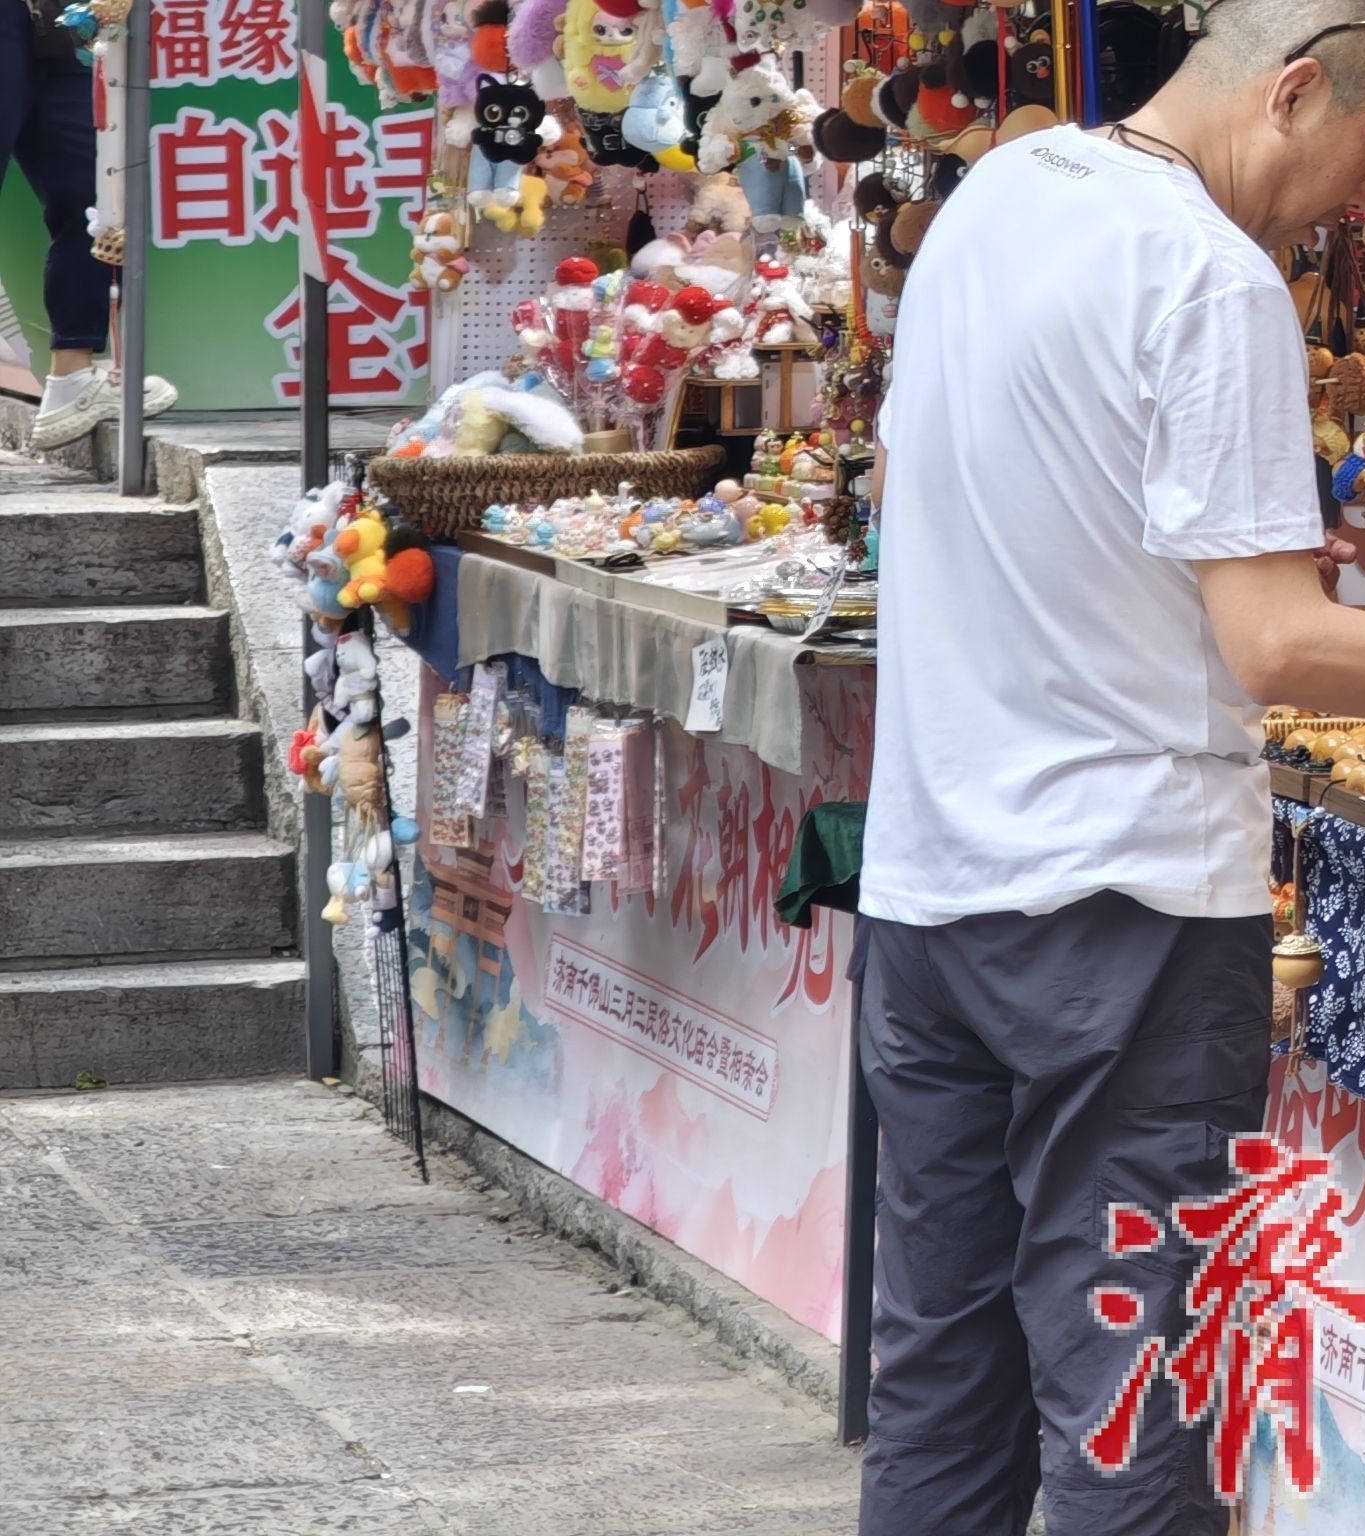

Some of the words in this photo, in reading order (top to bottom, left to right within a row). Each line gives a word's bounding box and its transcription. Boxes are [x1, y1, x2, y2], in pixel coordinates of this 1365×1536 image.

[1031, 148, 1096, 180] Discovery
[552, 950, 769, 1096] 济南千佛山三月三民俗文化庙会暨相亲会
